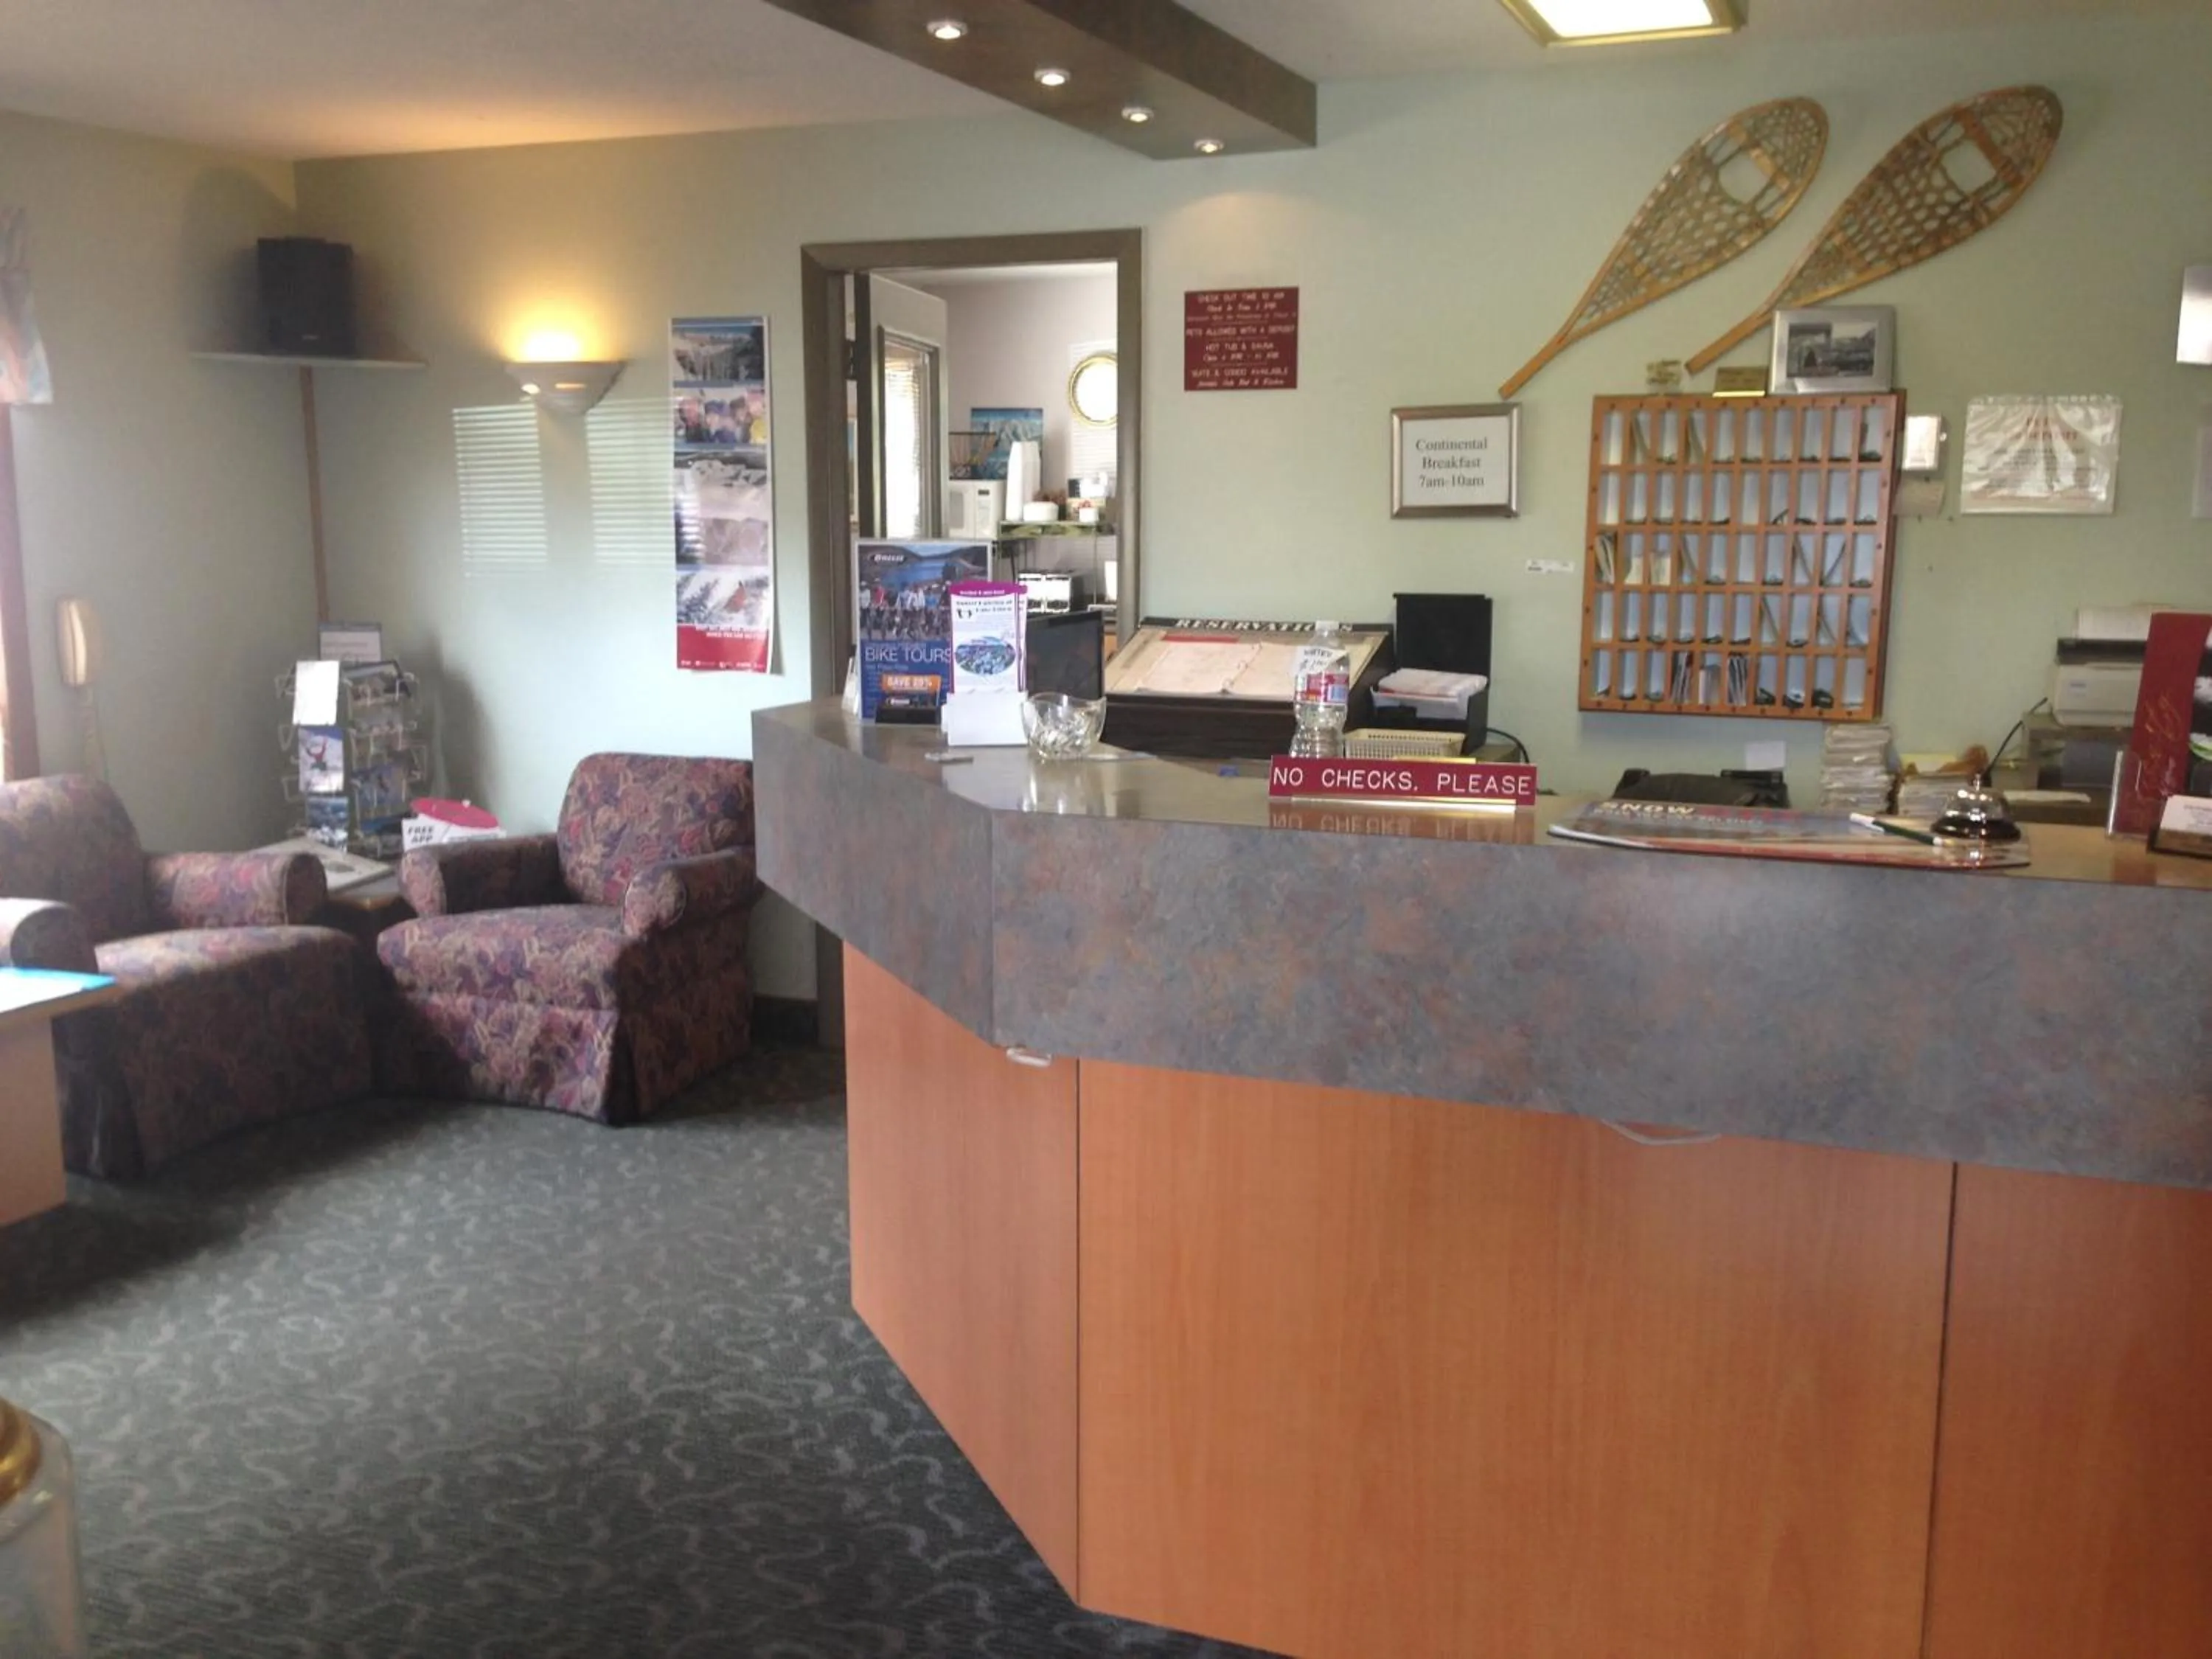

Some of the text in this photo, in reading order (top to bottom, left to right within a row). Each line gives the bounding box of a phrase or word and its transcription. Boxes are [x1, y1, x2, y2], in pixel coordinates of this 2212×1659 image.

[1416, 437, 1488, 451] Continental
[1422, 455, 1481, 470] Breakfast
[1419, 474, 1485, 488] 7am-10am
[1175, 619, 1353, 632] RESERVATIOS
[864, 648, 952, 663] BIKE TOURS
[1273, 767, 1304, 787] NO
[1437, 773, 1531, 796] PLEASE
[408, 825, 434, 835] FREE
[411, 835, 433, 844] APP
